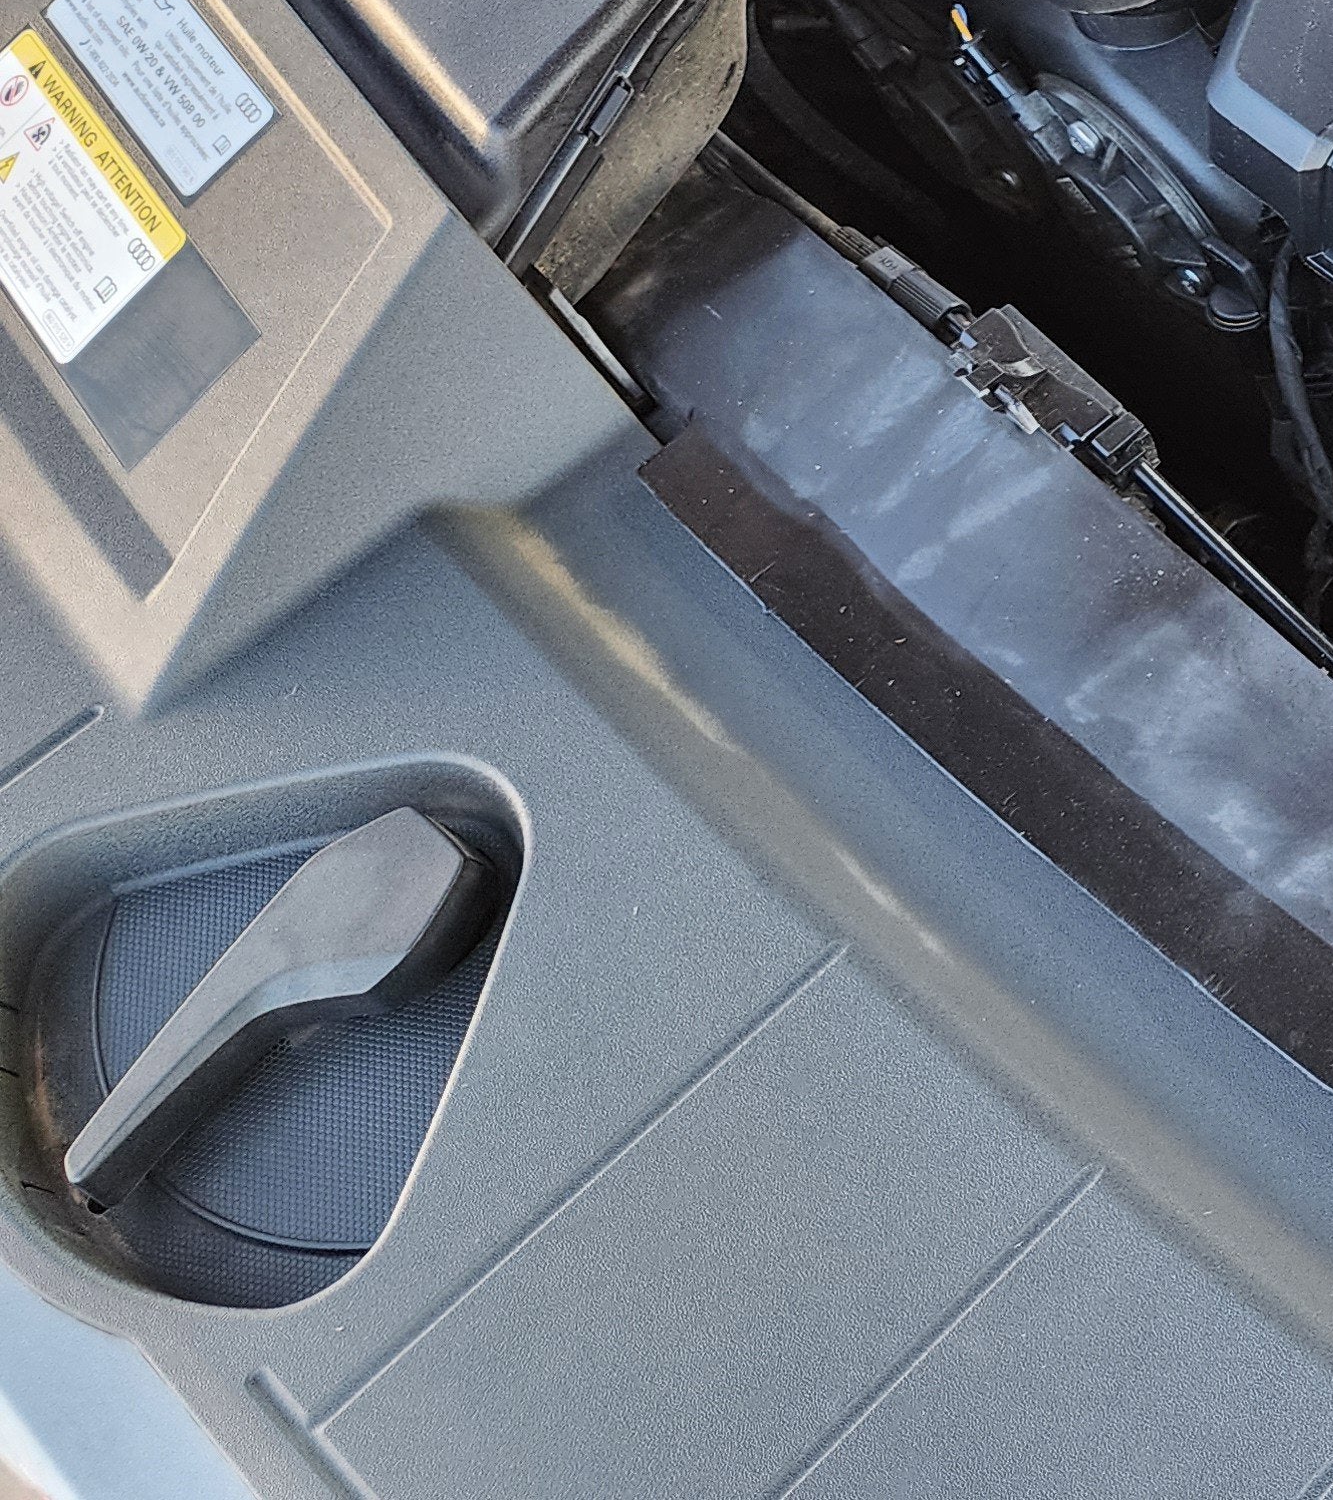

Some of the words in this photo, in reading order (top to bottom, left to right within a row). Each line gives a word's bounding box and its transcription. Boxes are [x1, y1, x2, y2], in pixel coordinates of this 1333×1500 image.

[114, 14, 136, 38] SAE
[129, 34, 160, 69] 0W-20
[154, 65, 166, 77] &
[161, 74, 182, 97] VW
[176, 93, 196, 115] 508
[190, 112, 206, 129] 00
[175, 17, 199, 43] Huile
[194, 41, 225, 77] moteur
[38, 73, 100, 149] WARNING
[93, 148, 163, 234] ATTENTION
